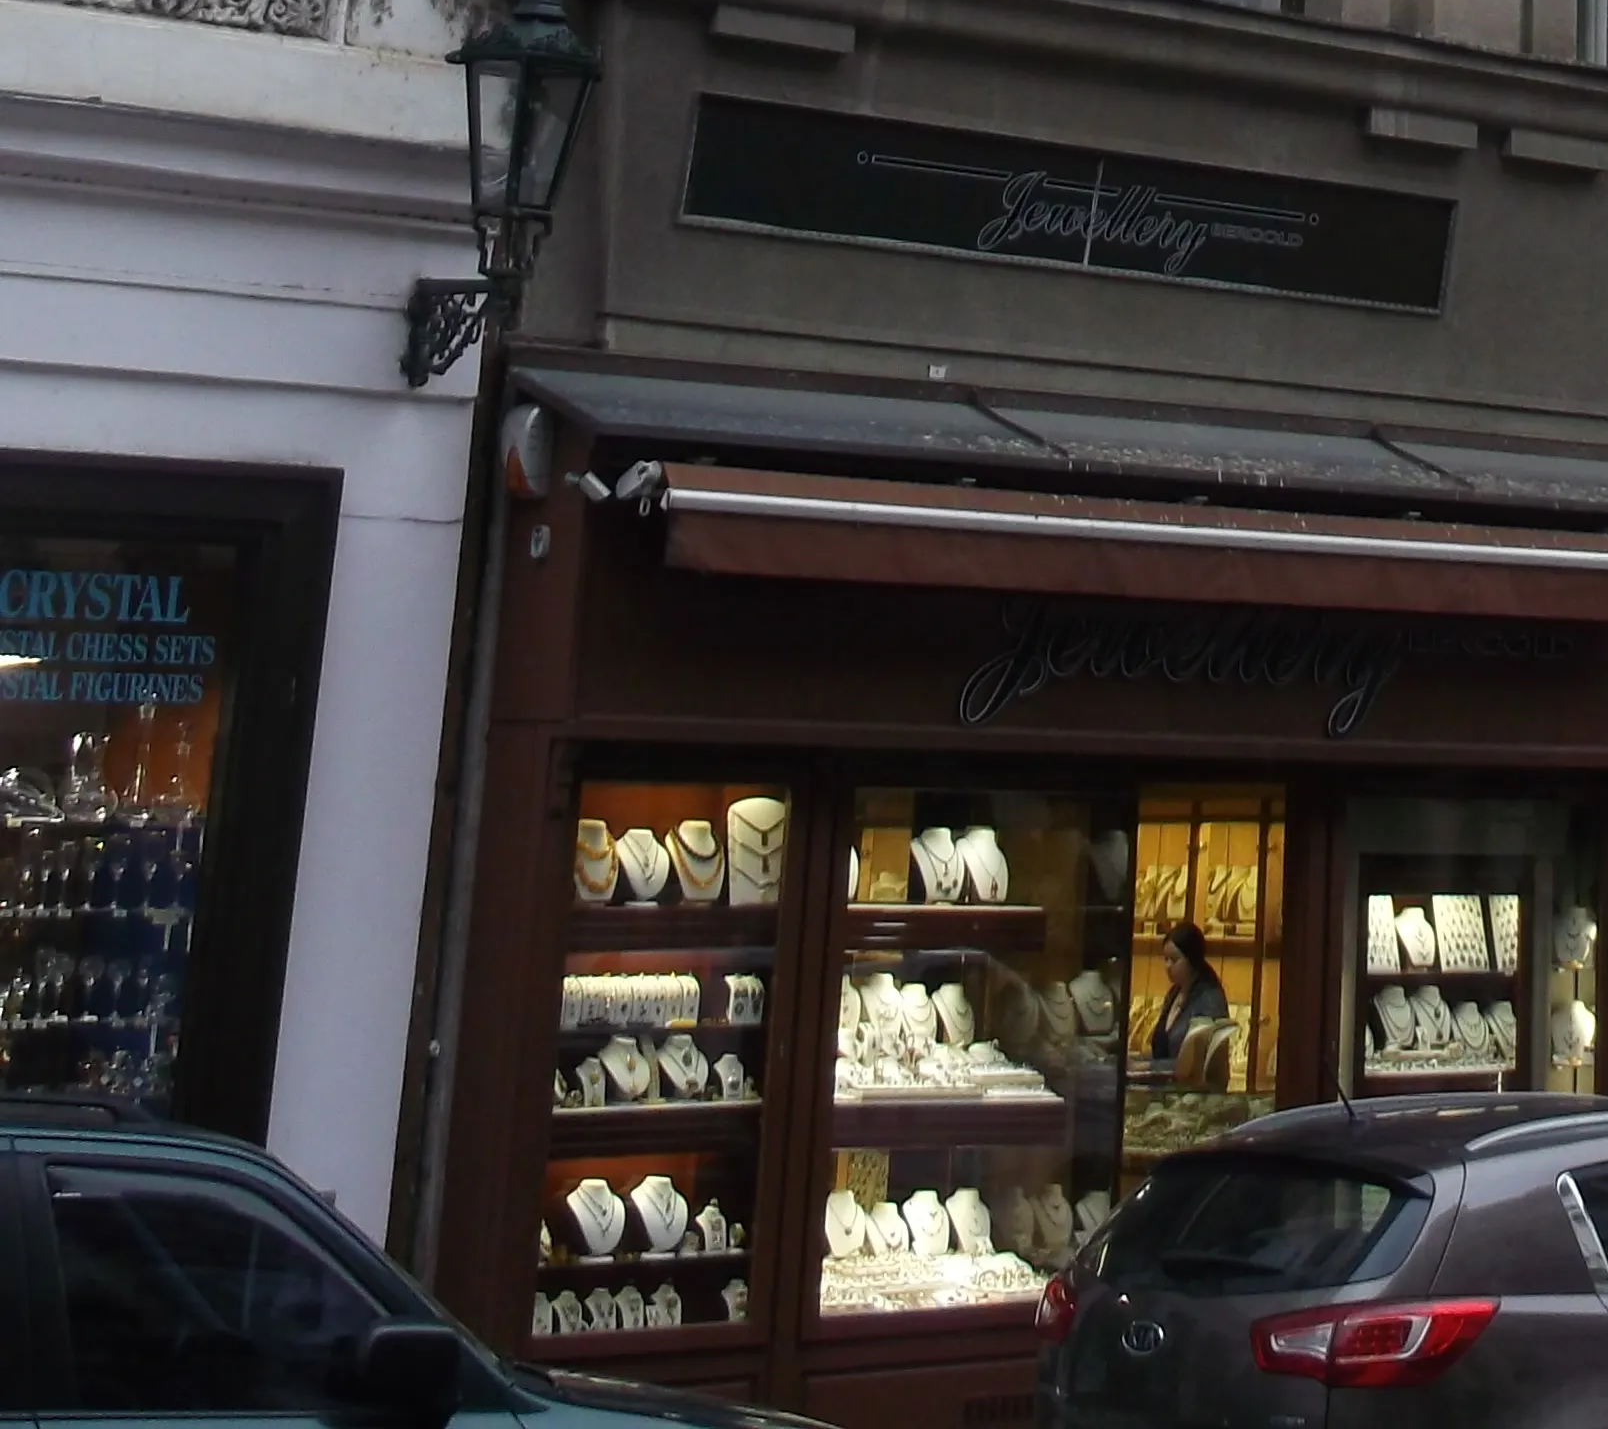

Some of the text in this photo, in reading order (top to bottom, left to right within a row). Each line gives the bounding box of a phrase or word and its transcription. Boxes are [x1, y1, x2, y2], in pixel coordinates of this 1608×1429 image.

[978, 172, 1208, 274] Jewellery
[0, 568, 191, 624] CRYSTAL
[66, 631, 149, 665] CHESS
[153, 634, 217, 666] SETS
[69, 671, 204, 704] FIGURINES
